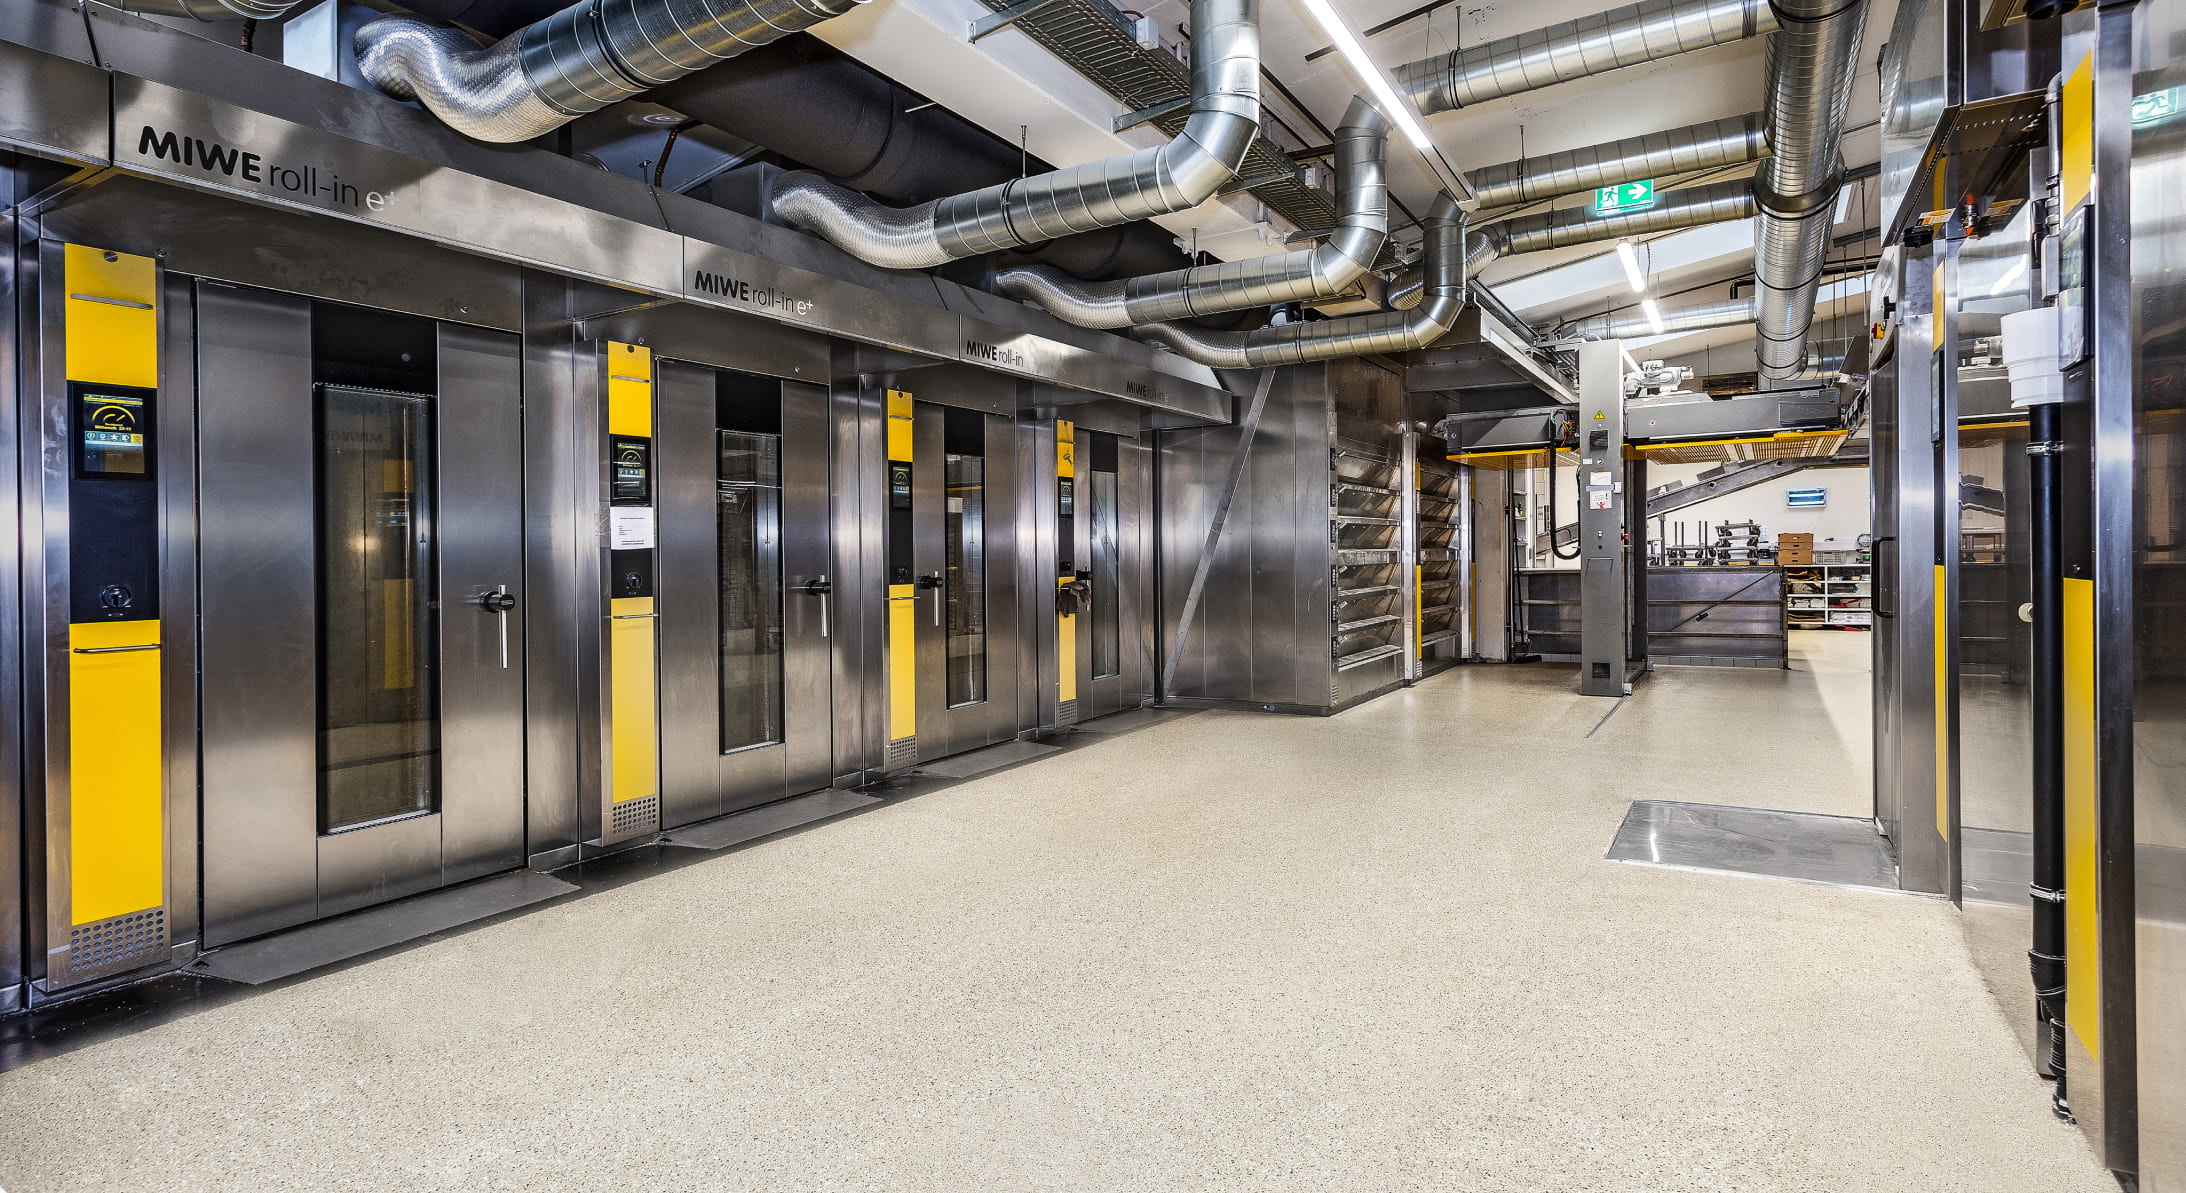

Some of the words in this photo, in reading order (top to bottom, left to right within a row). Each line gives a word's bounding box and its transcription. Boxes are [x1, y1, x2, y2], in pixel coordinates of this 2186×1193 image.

[138, 125, 261, 183] MIWE
[270, 164, 359, 207] roll-in
[694, 270, 749, 301] MIWE
[752, 287, 794, 313] roll-in
[966, 340, 997, 361] MIWE
[998, 348, 1024, 367] roll-in
[1126, 380, 1147, 397] MIWE
